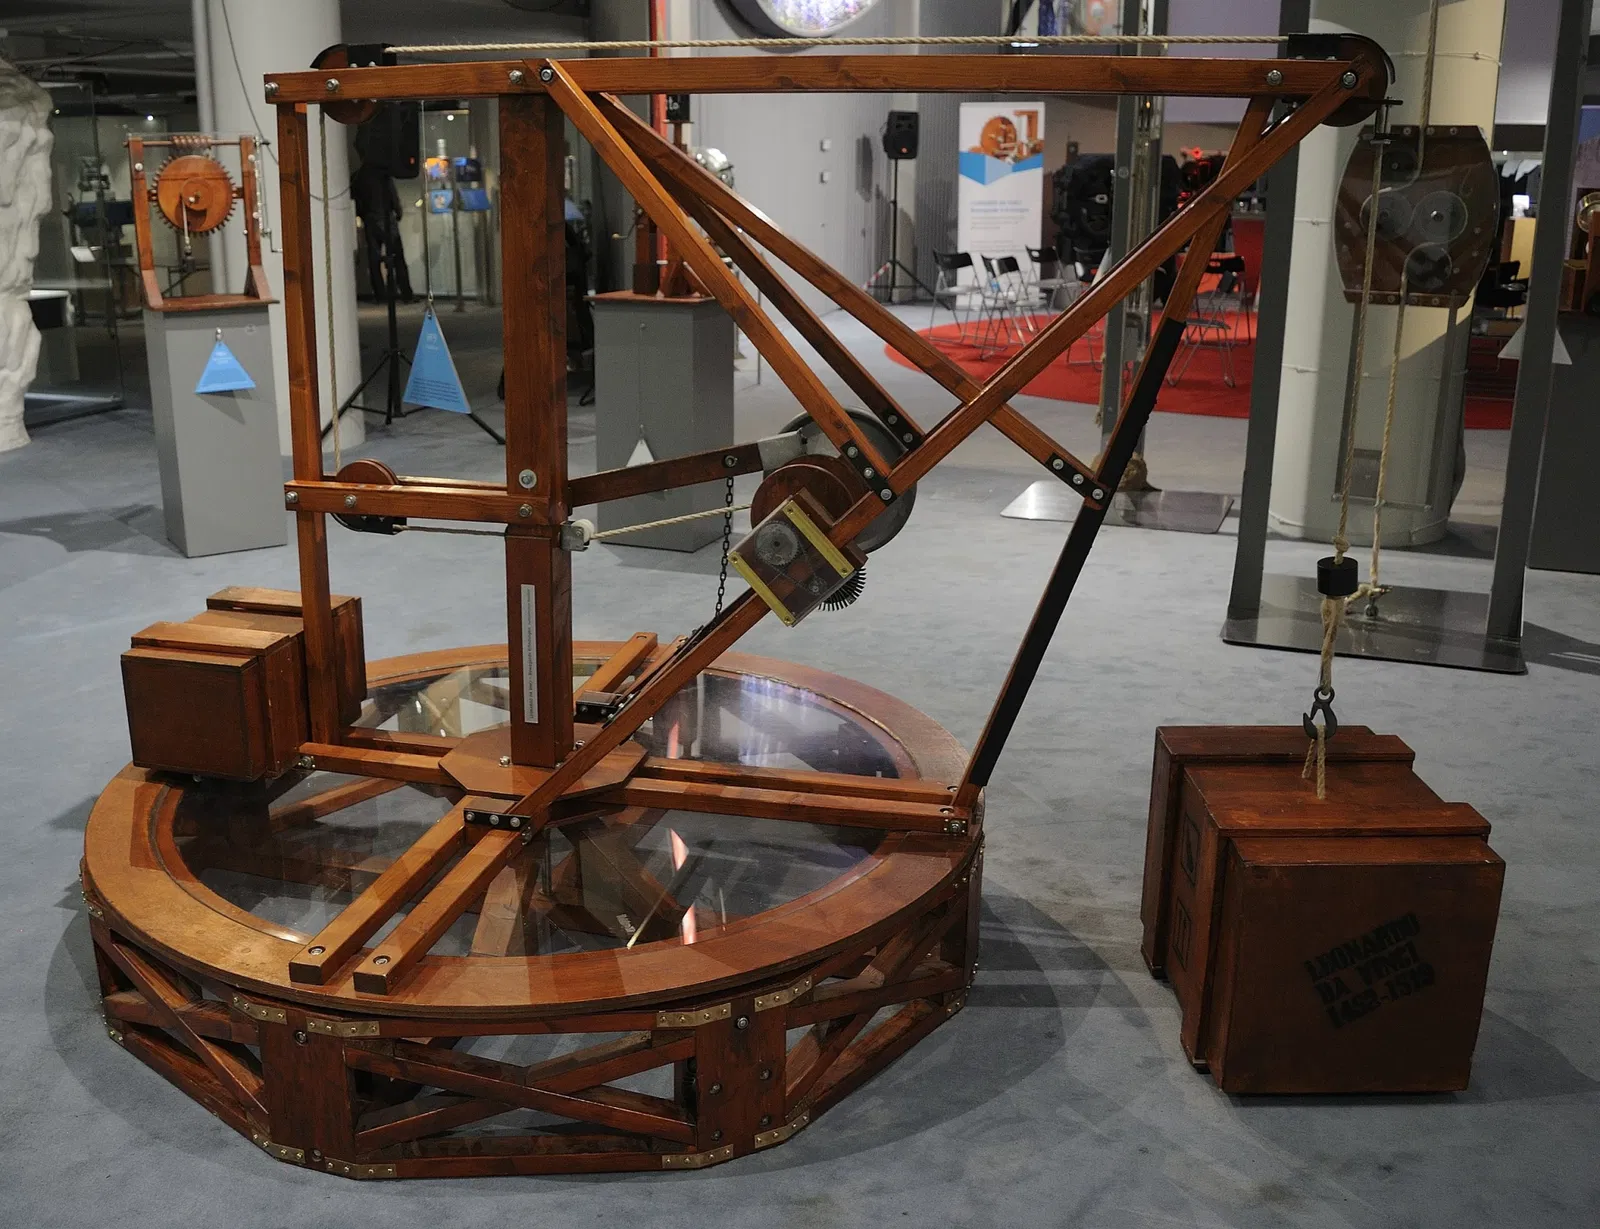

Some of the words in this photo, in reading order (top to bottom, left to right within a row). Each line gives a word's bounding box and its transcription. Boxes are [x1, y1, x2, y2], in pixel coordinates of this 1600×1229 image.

[1304, 911, 1420, 983] LEONARDO
[1313, 976, 1352, 1004] DA
[1357, 940, 1420, 986] VINCI
